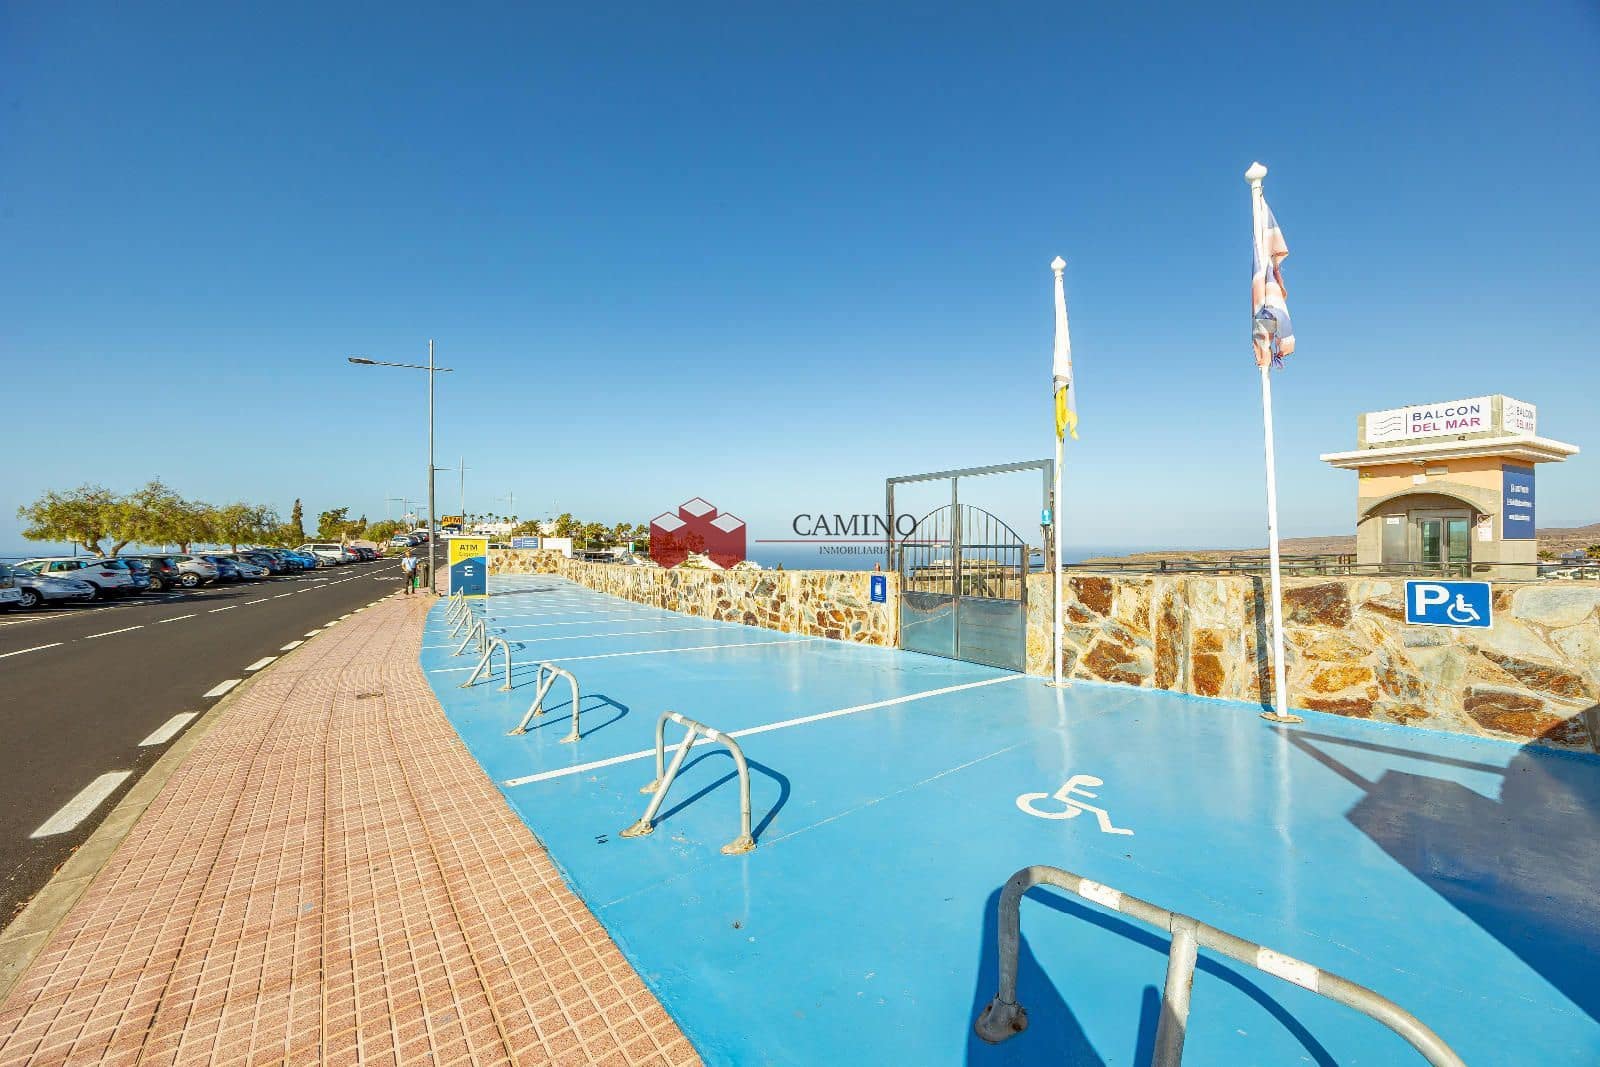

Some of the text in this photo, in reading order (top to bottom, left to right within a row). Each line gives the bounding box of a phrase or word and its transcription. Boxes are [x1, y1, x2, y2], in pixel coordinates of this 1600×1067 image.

[1412, 404, 1480, 421] BALCON
[1412, 417, 1480, 433] DEL MAR
[1415, 584, 1449, 615] P
